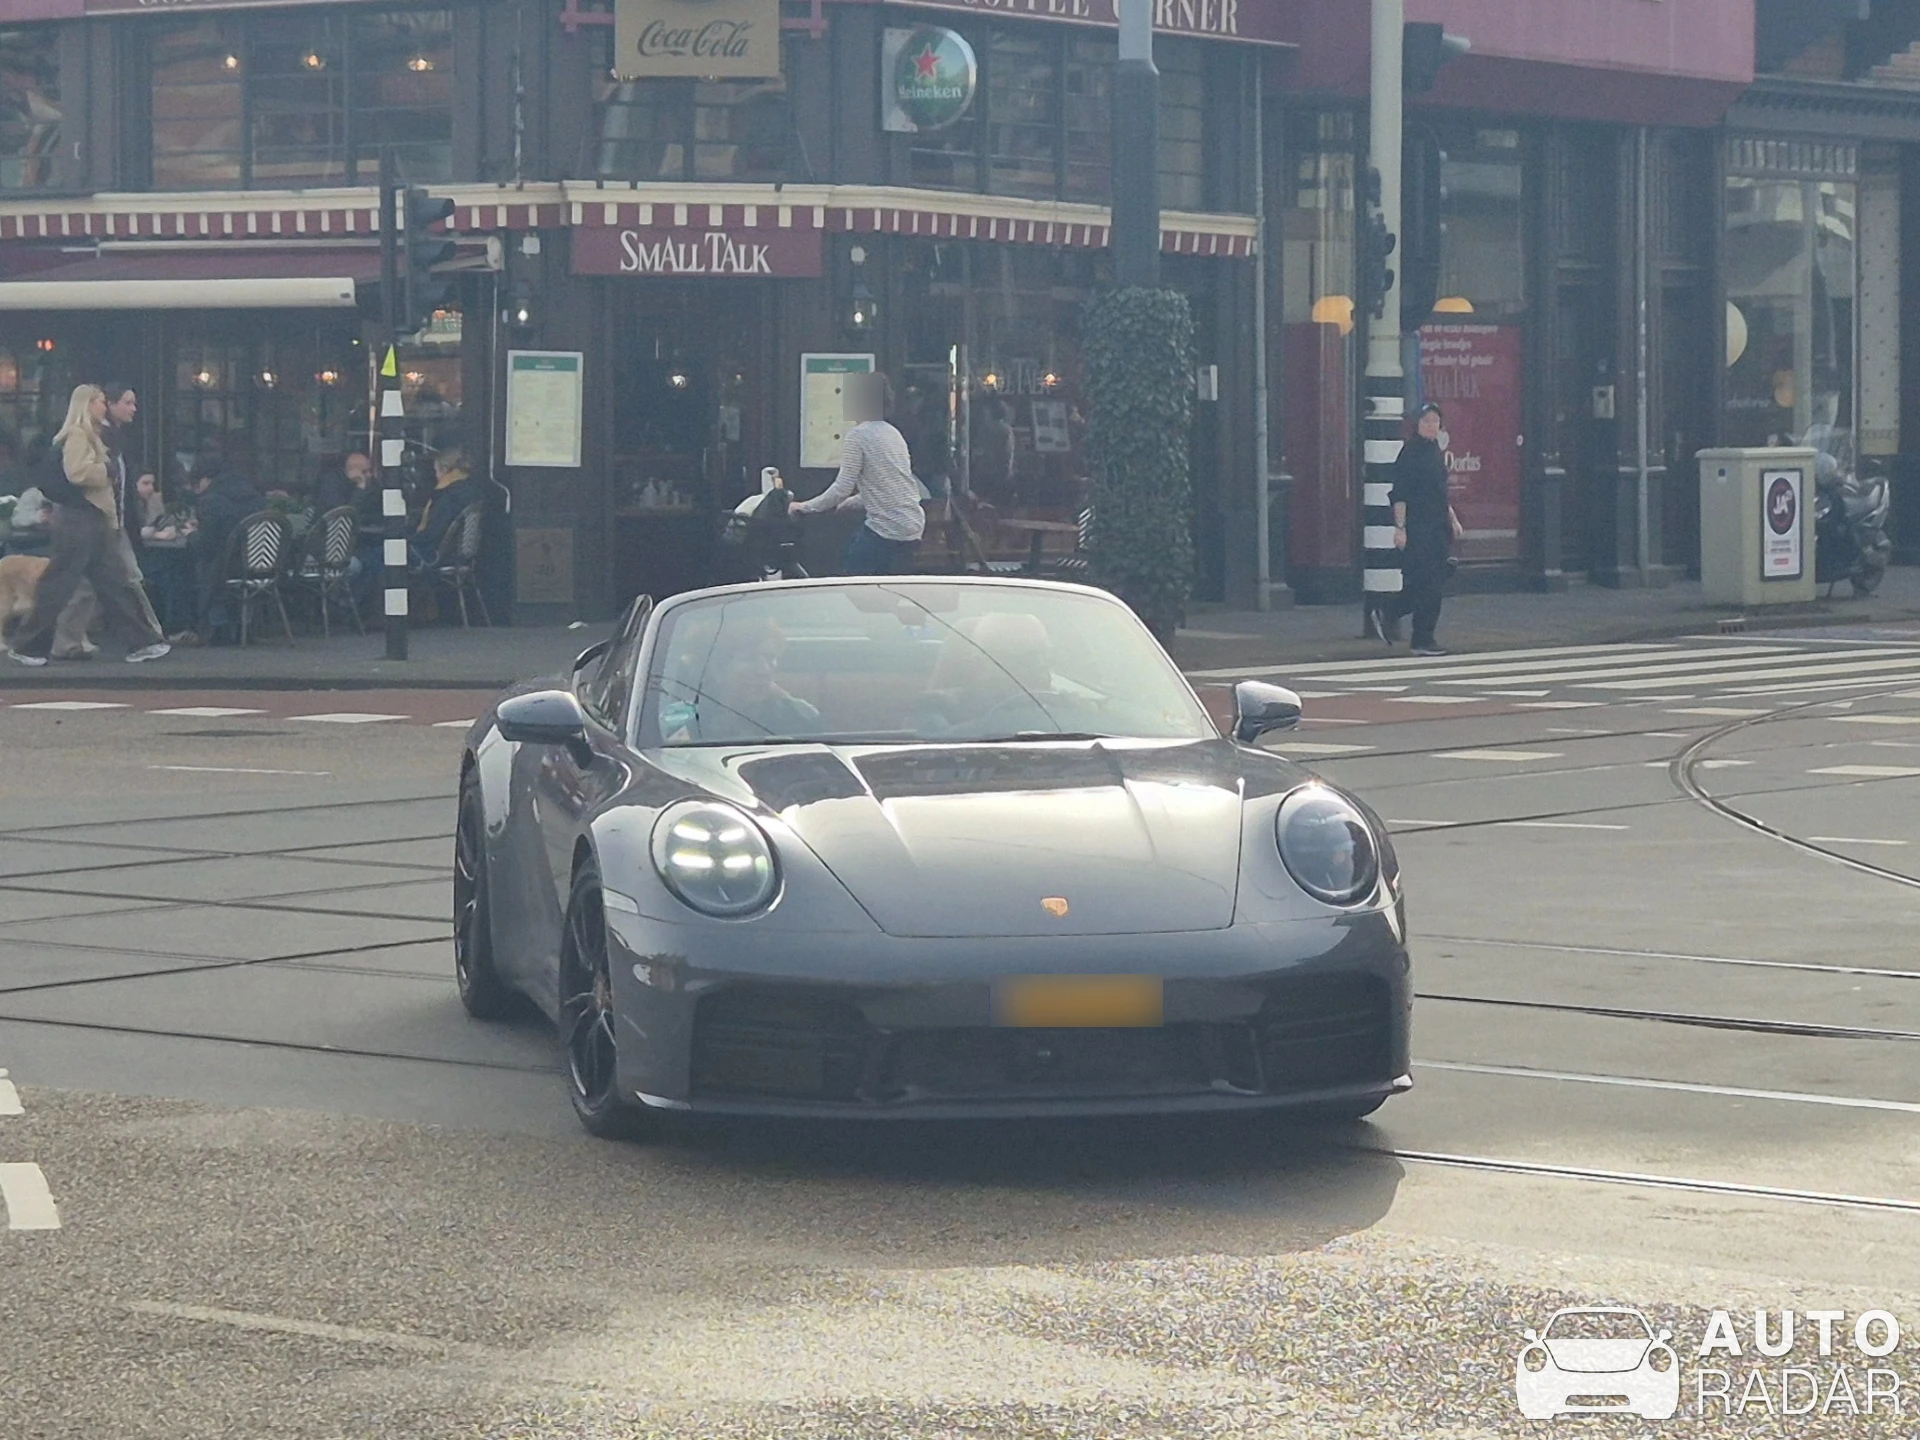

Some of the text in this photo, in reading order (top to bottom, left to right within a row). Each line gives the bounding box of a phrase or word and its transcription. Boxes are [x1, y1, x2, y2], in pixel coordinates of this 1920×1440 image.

[1113, 0, 1238, 34] RNER
[620, 229, 772, 274] SMALL TALK
